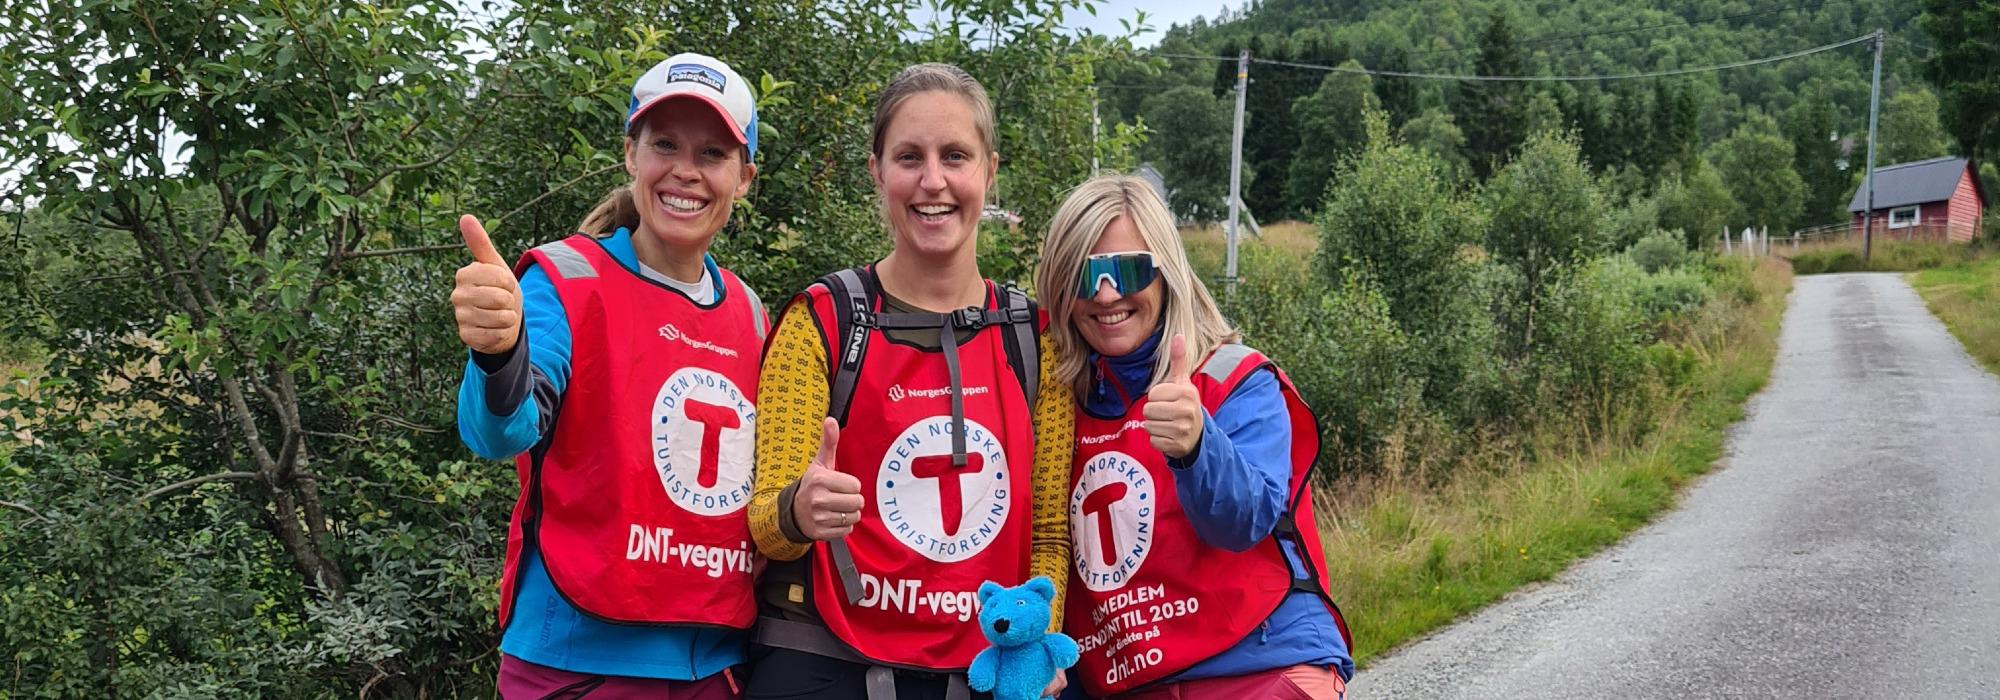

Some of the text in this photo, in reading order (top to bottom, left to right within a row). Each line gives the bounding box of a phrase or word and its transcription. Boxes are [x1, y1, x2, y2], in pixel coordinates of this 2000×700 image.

[671, 74, 721, 89] patagonia
[664, 372, 756, 423] DEN NORSKE
[908, 386, 988, 398] NorgesGppen
[888, 433, 921, 472] DEN
[1088, 456, 1146, 488] NORSKE
[885, 489, 1007, 555] TURISTFORENING
[1099, 582, 1165, 615] MEDLEM
[1121, 609, 1147, 629] TIL
[1149, 597, 1199, 622] 2030
[1144, 625, 1160, 641] på
[1106, 647, 1163, 685] dnt.no
